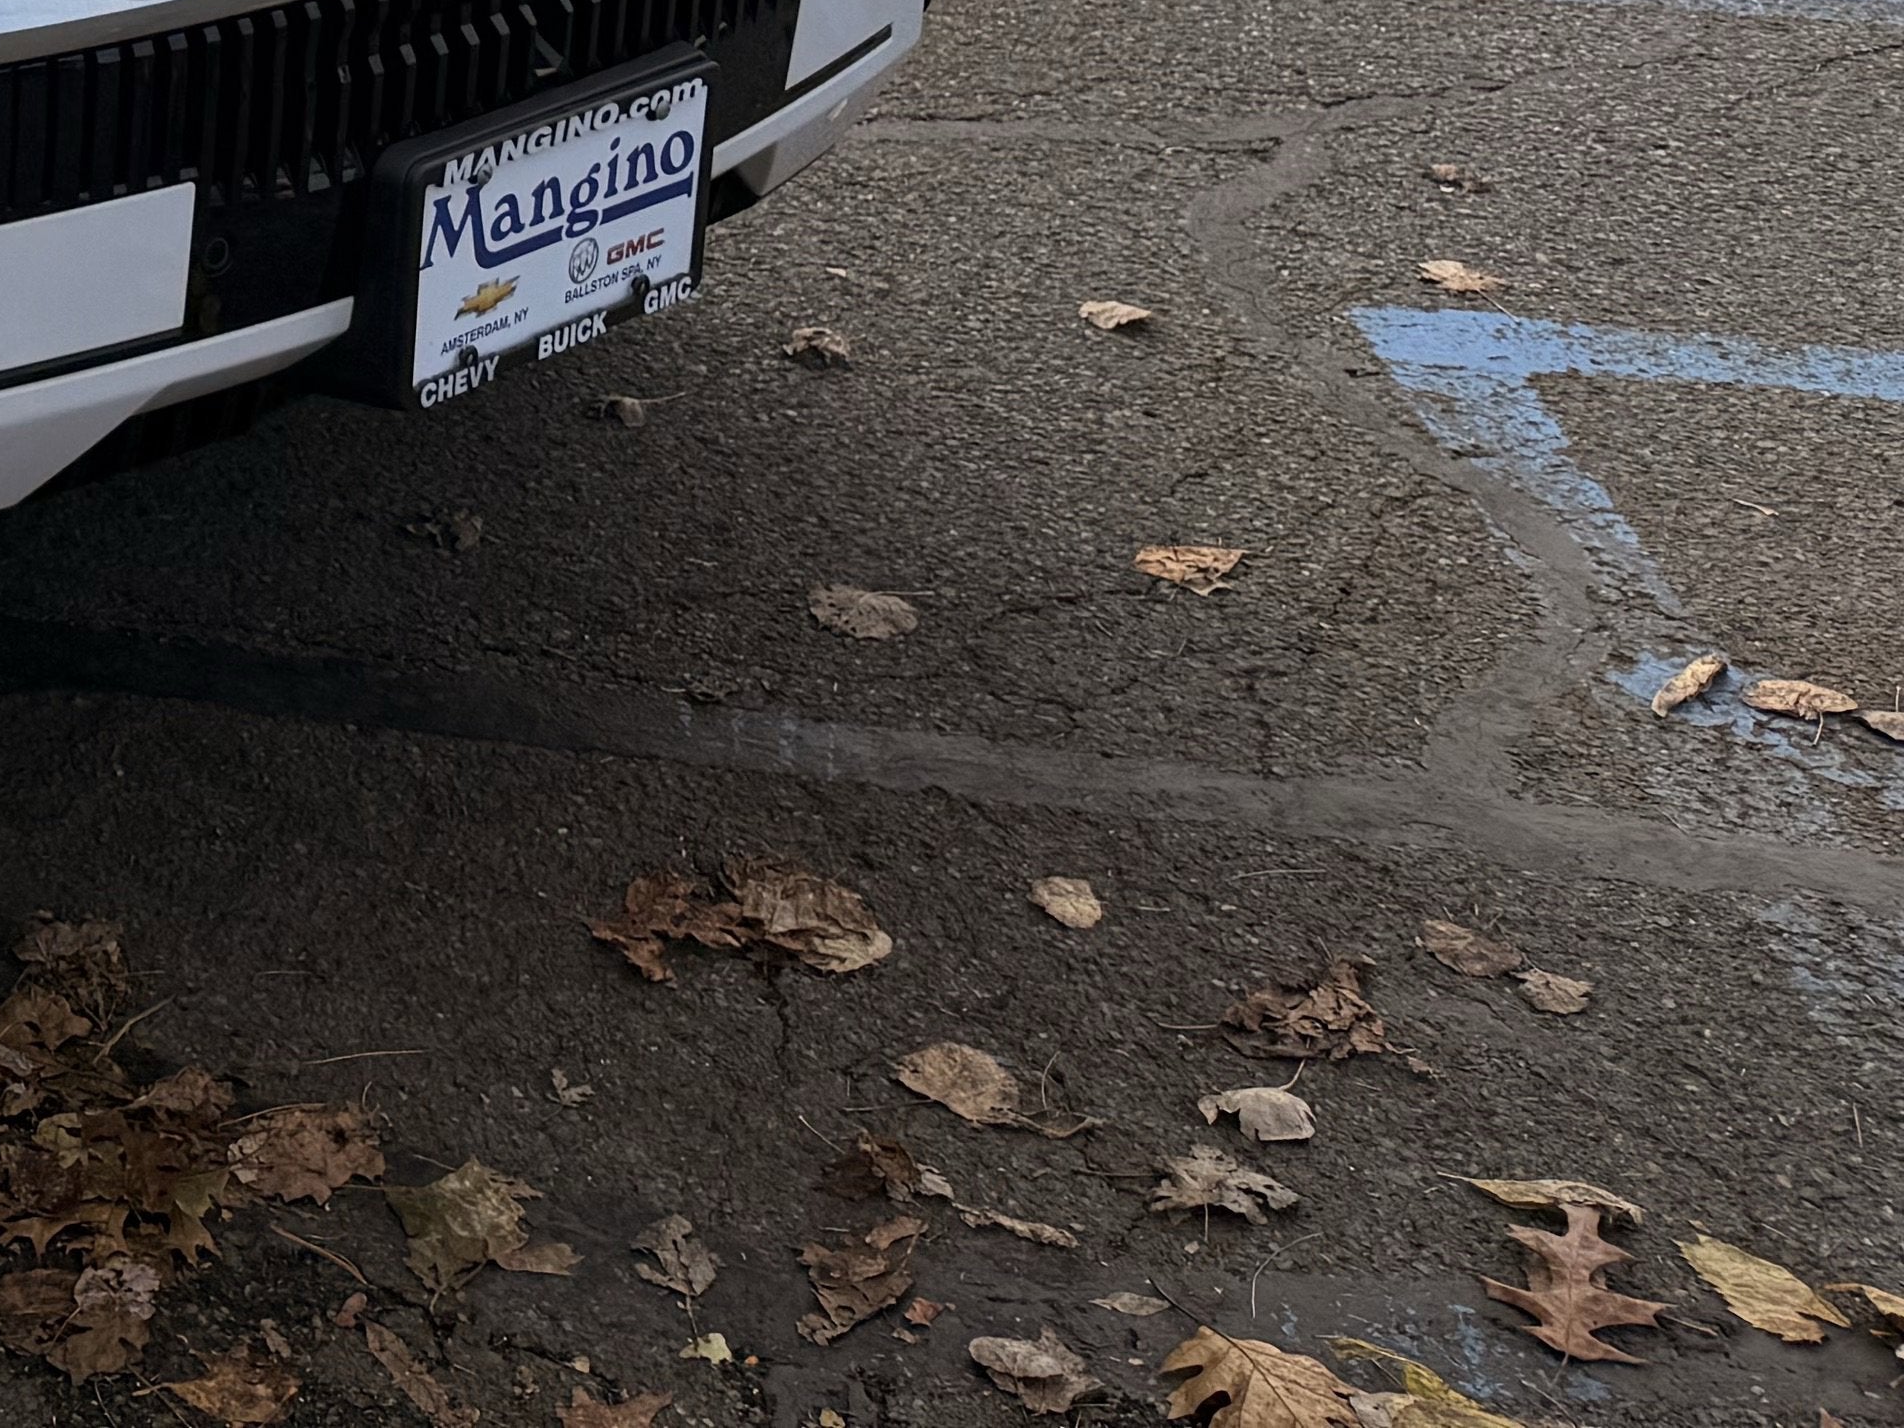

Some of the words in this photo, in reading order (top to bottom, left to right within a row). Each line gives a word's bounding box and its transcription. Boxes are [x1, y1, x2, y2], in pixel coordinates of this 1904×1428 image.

[443, 77, 704, 188] MANGINO.com
[420, 130, 694, 270] Mangino
[565, 270, 619, 304] BALLSTON
[646, 254, 662, 270] NY
[607, 227, 665, 265] GMC
[420, 355, 500, 409] CHEVY
[538, 310, 607, 361] BUICK
[644, 276, 692, 315] GMC
[514, 306, 529, 324] NY
